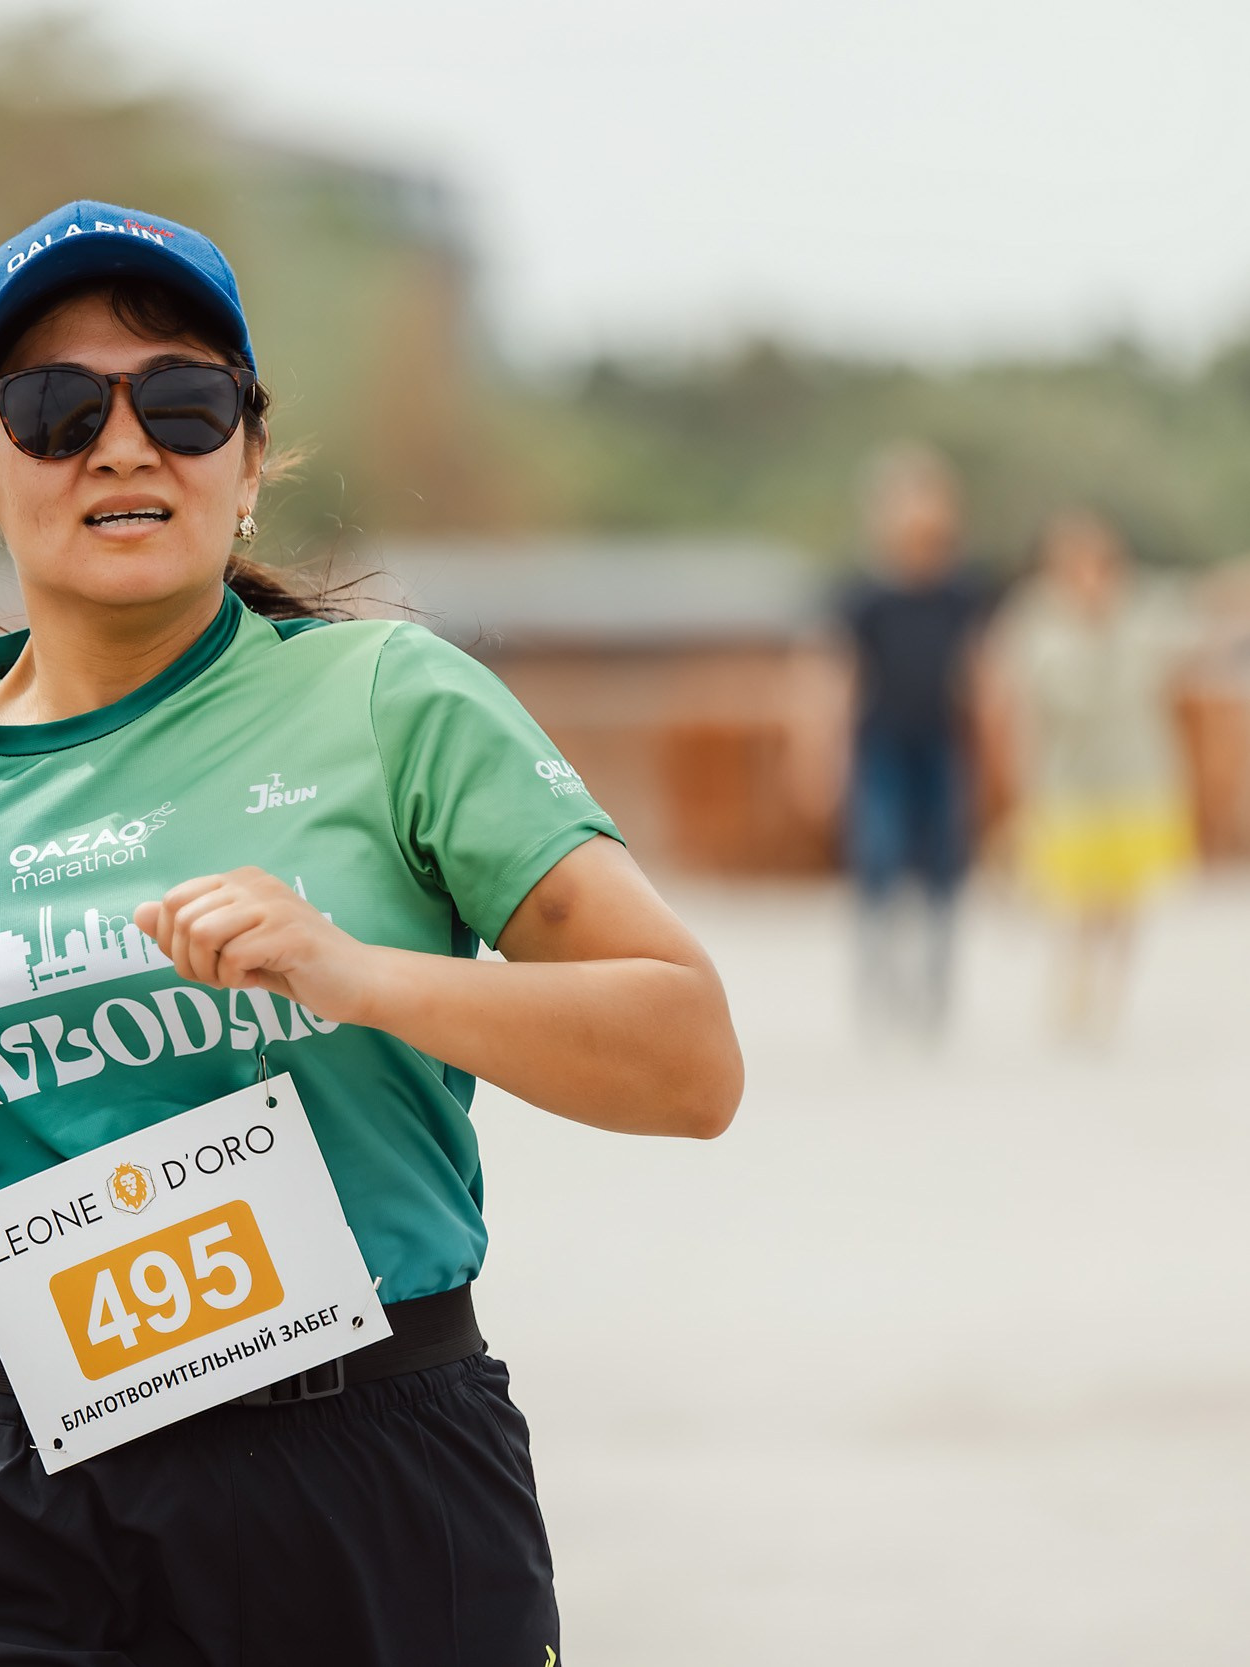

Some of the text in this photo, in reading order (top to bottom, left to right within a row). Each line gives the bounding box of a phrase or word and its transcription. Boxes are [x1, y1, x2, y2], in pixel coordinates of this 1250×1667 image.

[244, 784, 318, 814] JRUN
[12, 844, 147, 893] marathon
[161, 1125, 275, 1190] D'ORO
[85, 1222, 253, 1350] 495
[60, 1304, 341, 1432] БЛАГОТВОРИТЕЛЬНЫЙ ЗАБЕГ
